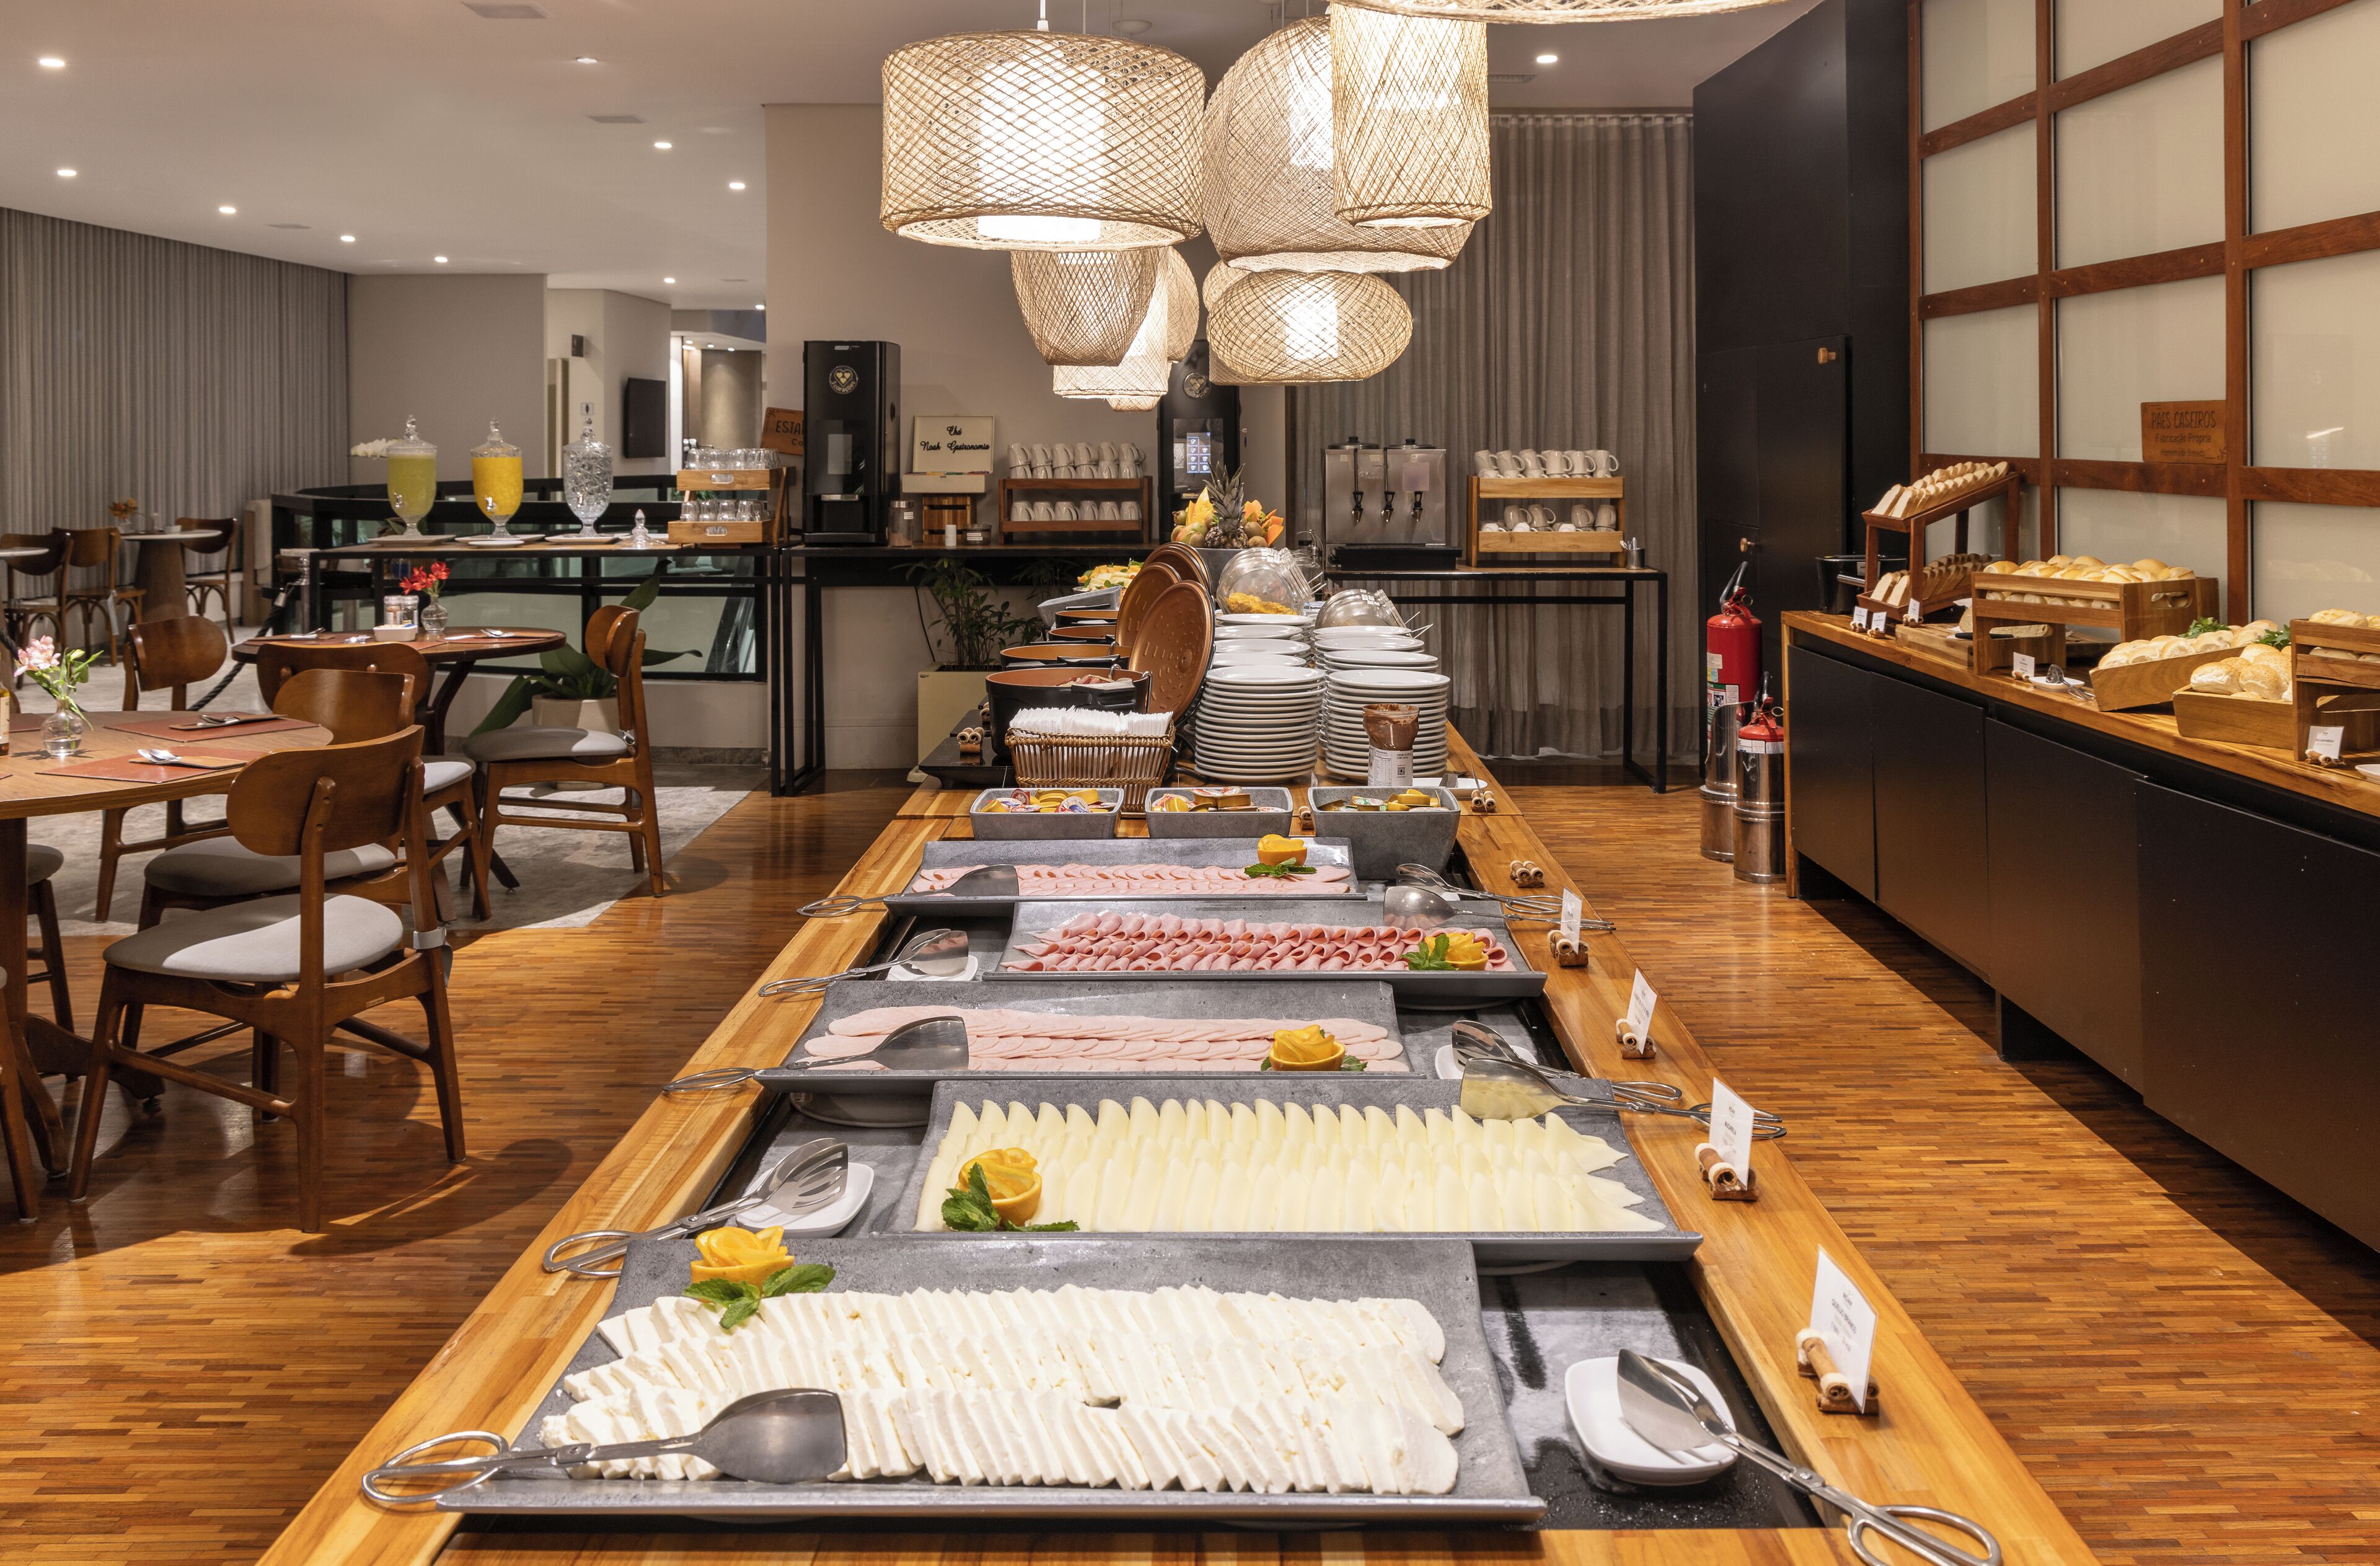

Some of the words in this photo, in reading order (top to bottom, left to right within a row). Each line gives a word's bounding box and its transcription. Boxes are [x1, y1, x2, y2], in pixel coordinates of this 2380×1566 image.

[2174, 410, 2216, 428] CASEIROS
[920, 441, 941, 451] Noah
[946, 440, 990, 454] Gastronomia
